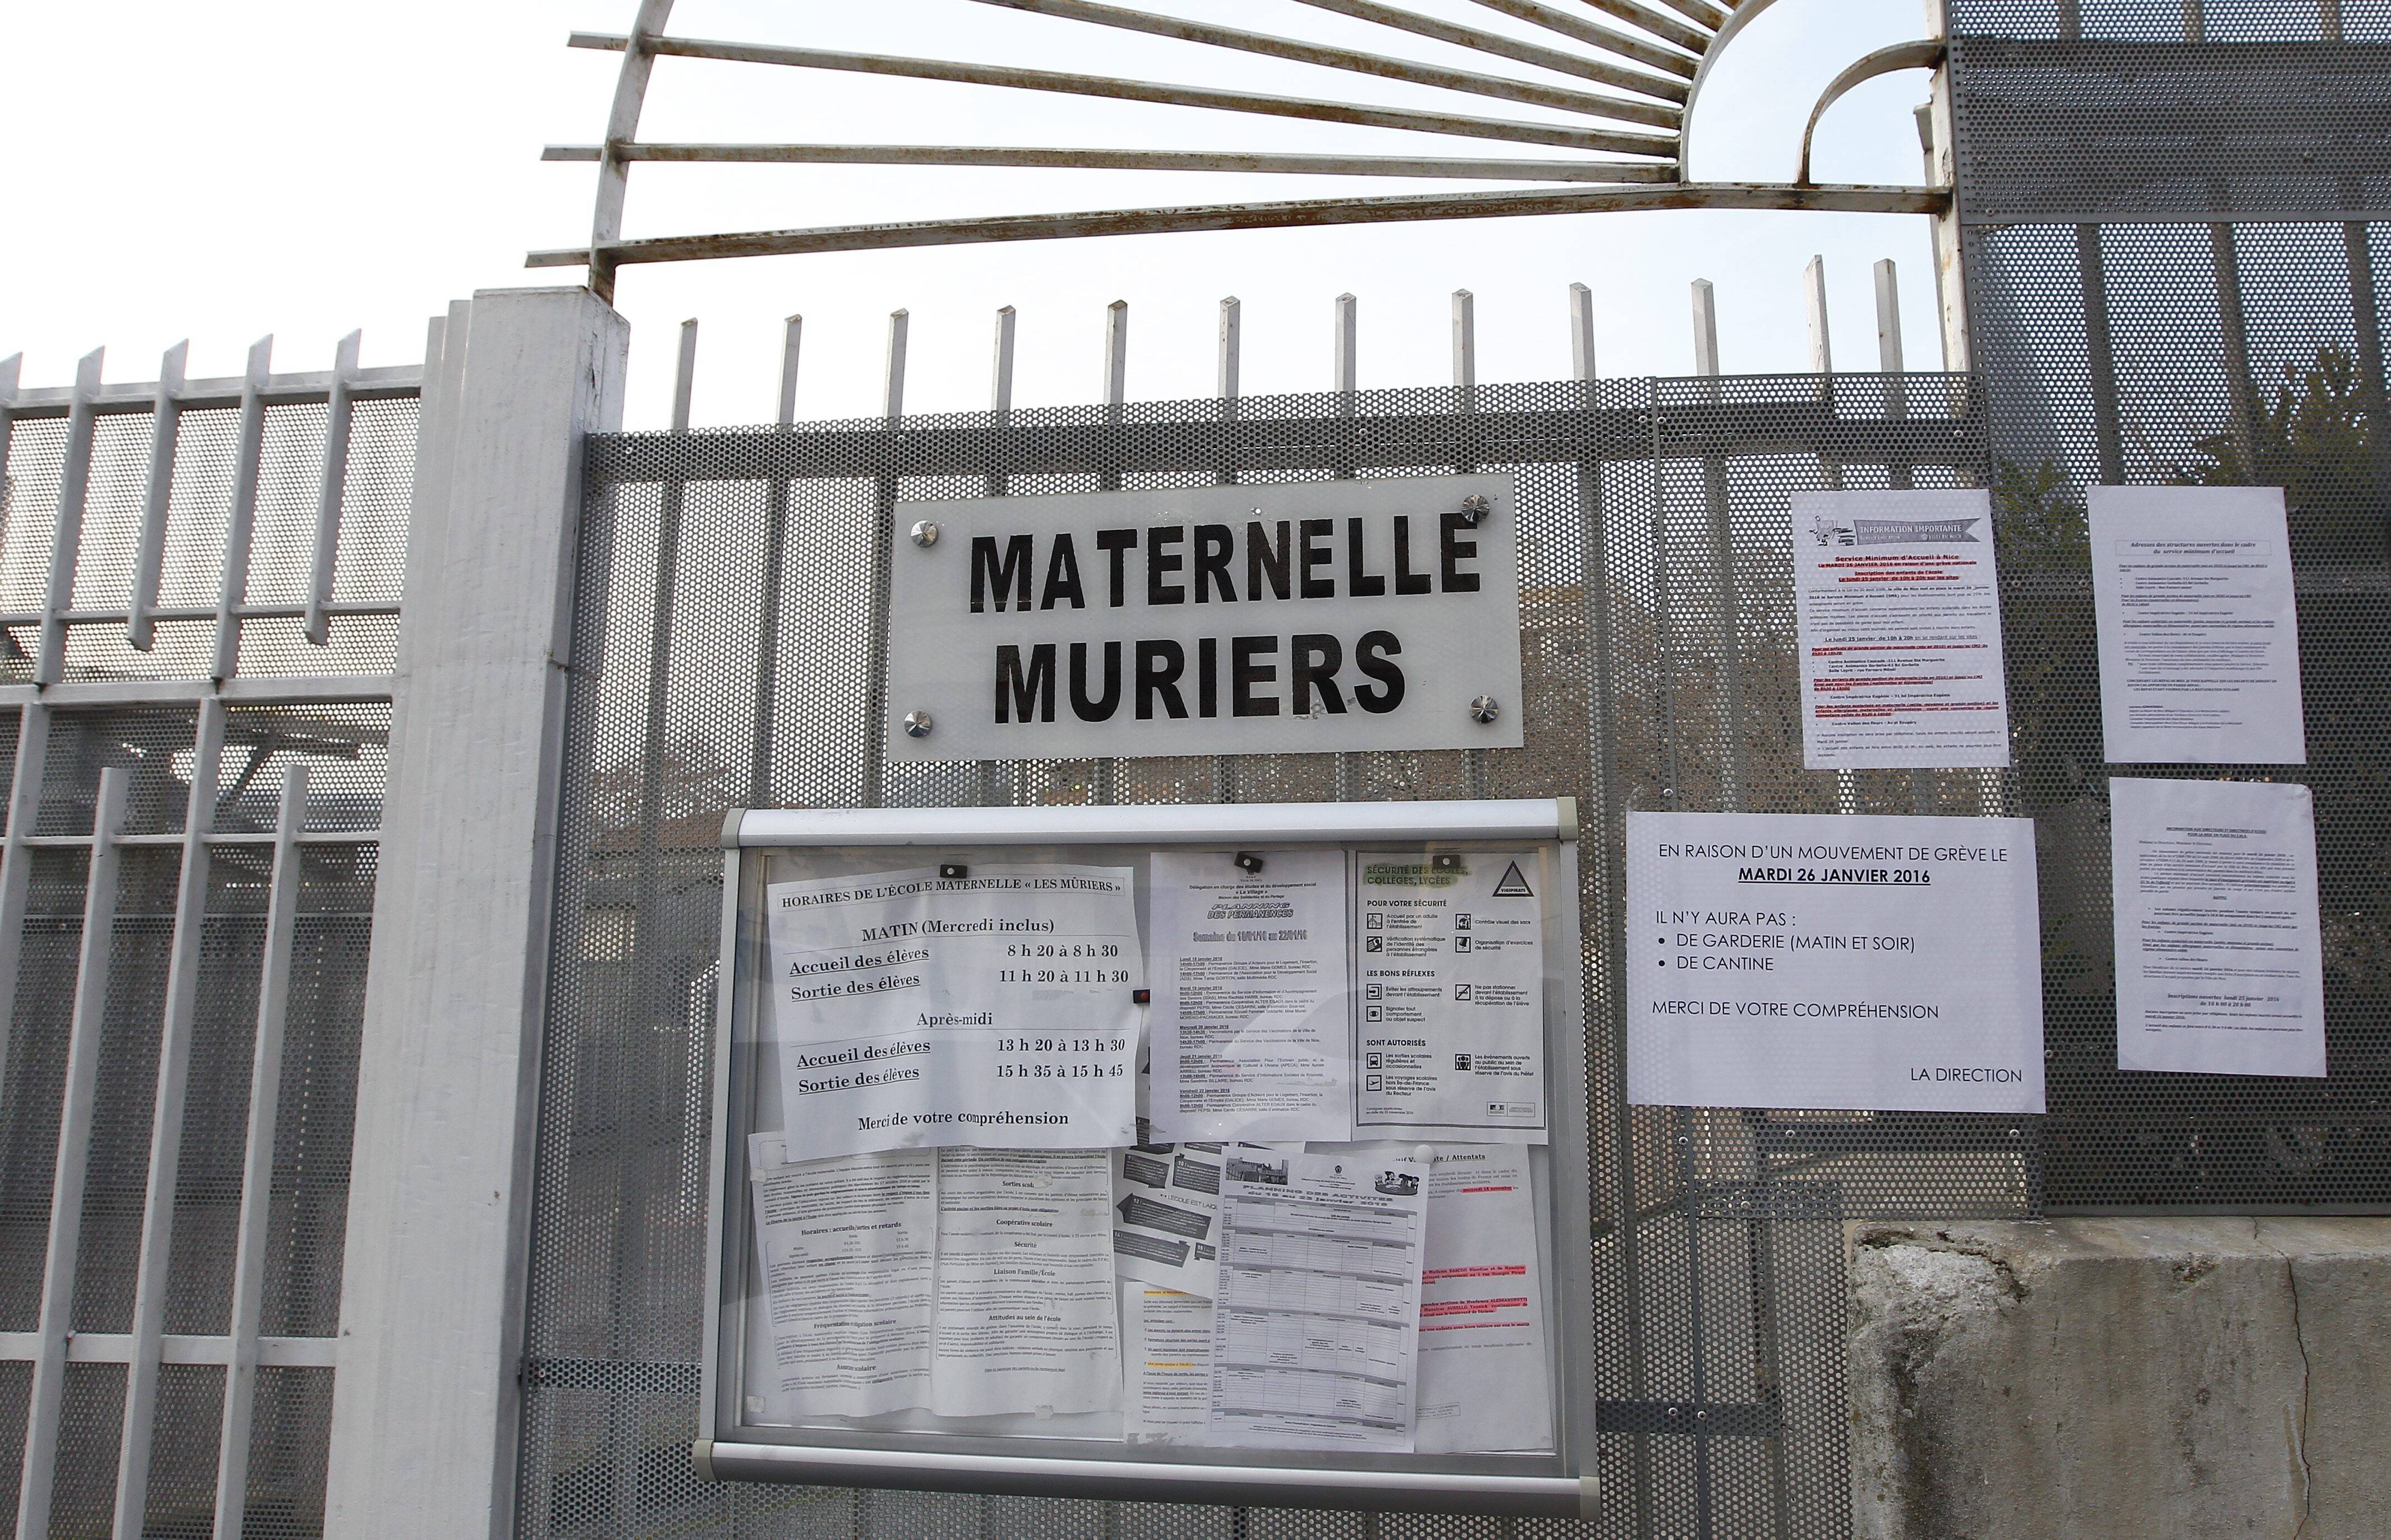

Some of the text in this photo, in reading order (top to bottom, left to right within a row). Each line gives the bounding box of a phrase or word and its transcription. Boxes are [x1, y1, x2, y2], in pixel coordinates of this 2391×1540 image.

[1861, 525, 1913, 534] INFORMATION
[970, 512, 1480, 614] MATERNELLE
[995, 629, 1405, 724] MURIERS
[1659, 844, 2007, 861] EN RAISON D'UN MOUVEMENT DE GRÈVE LE
[1368, 865, 1409, 873] SÉCURITÉ
[1739, 868, 1931, 883] MARDI 26 JANVIER 2016
[1368, 875, 1450, 886] COLLÈGES, LYCÉES
[782, 892, 851, 908] HORAIRES
[855, 888, 873, 900] DE
[877, 881, 932, 898] L'ÉCOLE
[936, 879, 1021, 890] MATERNELLE
[1034, 879, 1057, 889] LES
[1060, 877, 1113, 891] MÛRIERS
[1414, 898, 1446, 907] SÉCURITÉ
[1208, 909, 1294, 919] DES PERMANENCES
[1656, 911, 1667, 923] IL
[1673, 911, 1700, 924] N'Y
[1705, 912, 1751, 925] AURA
[1755, 913, 1786, 926] PAS
[862, 918, 1055, 942] MATIN (Mercredi inclus)
[1676, 933, 1915, 953] DE GARDERIE (MATIN ET SOIR)
[1008, 945, 1118, 957] 8 h 20 à 8 h 30
[790, 949, 929, 975] Accueil des élèves
[1676, 956, 1774, 971] DE CANTINE
[1000, 970, 1128, 982] 11 h 20 à 11 h 30
[791, 975, 920, 1000] Sortie des élèves
[1652, 1000, 1938, 1019] MERCI DE VOTRE COMPRÉHENSION
[917, 1012, 993, 1028] Après-midi
[998, 1039, 1125, 1052] 13 h 20 à 13 h 30
[797, 1041, 931, 1067] Accueil des élèves
[998, 1064, 1123, 1077] 15 h 35 à 15 h 45
[1911, 1068, 2022, 1082] LA DIRECTION
[799, 1067, 919, 1094] Sortie des élèves
[858, 1111, 1069, 1131] Merci de votre compréhension
[996, 1219, 1030, 1227] Coopérative
